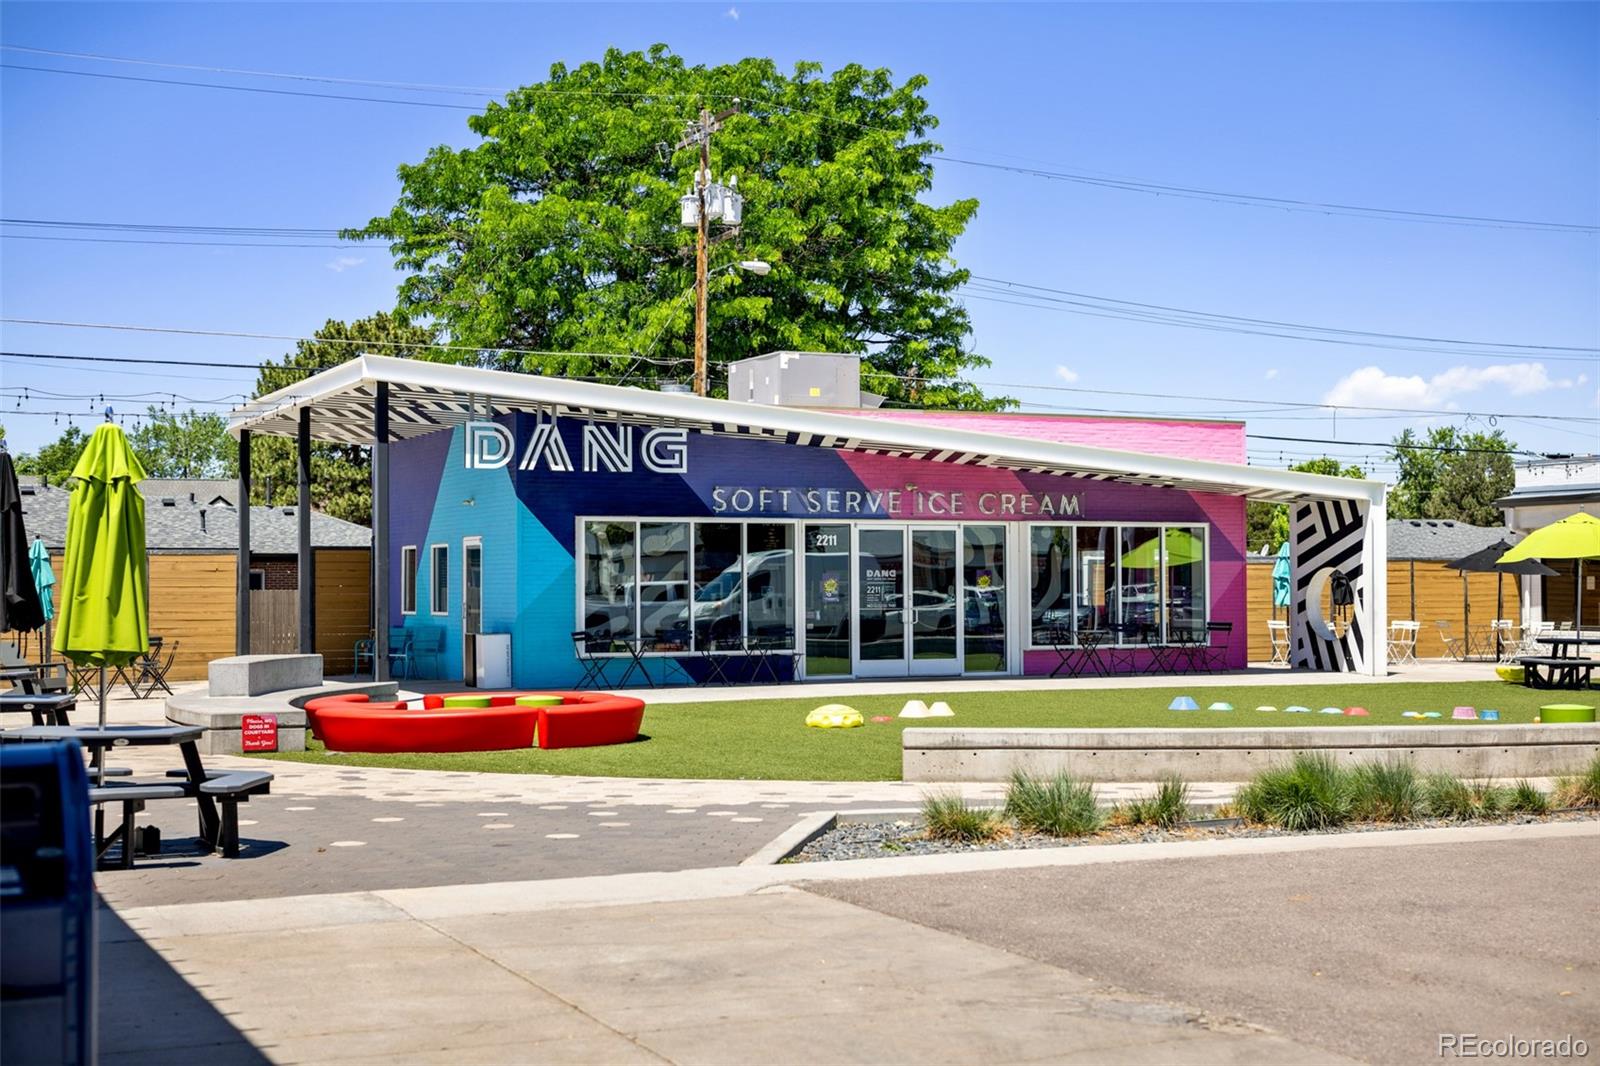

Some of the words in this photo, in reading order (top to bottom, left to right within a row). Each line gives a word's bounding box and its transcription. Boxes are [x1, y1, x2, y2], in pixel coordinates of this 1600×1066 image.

[464, 421, 689, 474] DANG
[712, 488, 792, 513] SOFT
[807, 490, 902, 513] SERVE
[917, 491, 964, 514] ICE
[978, 493, 1080, 516] CREAM
[816, 534, 837, 546] 2211
[866, 569, 896, 577] DANG
[866, 585, 881, 594] 2211
